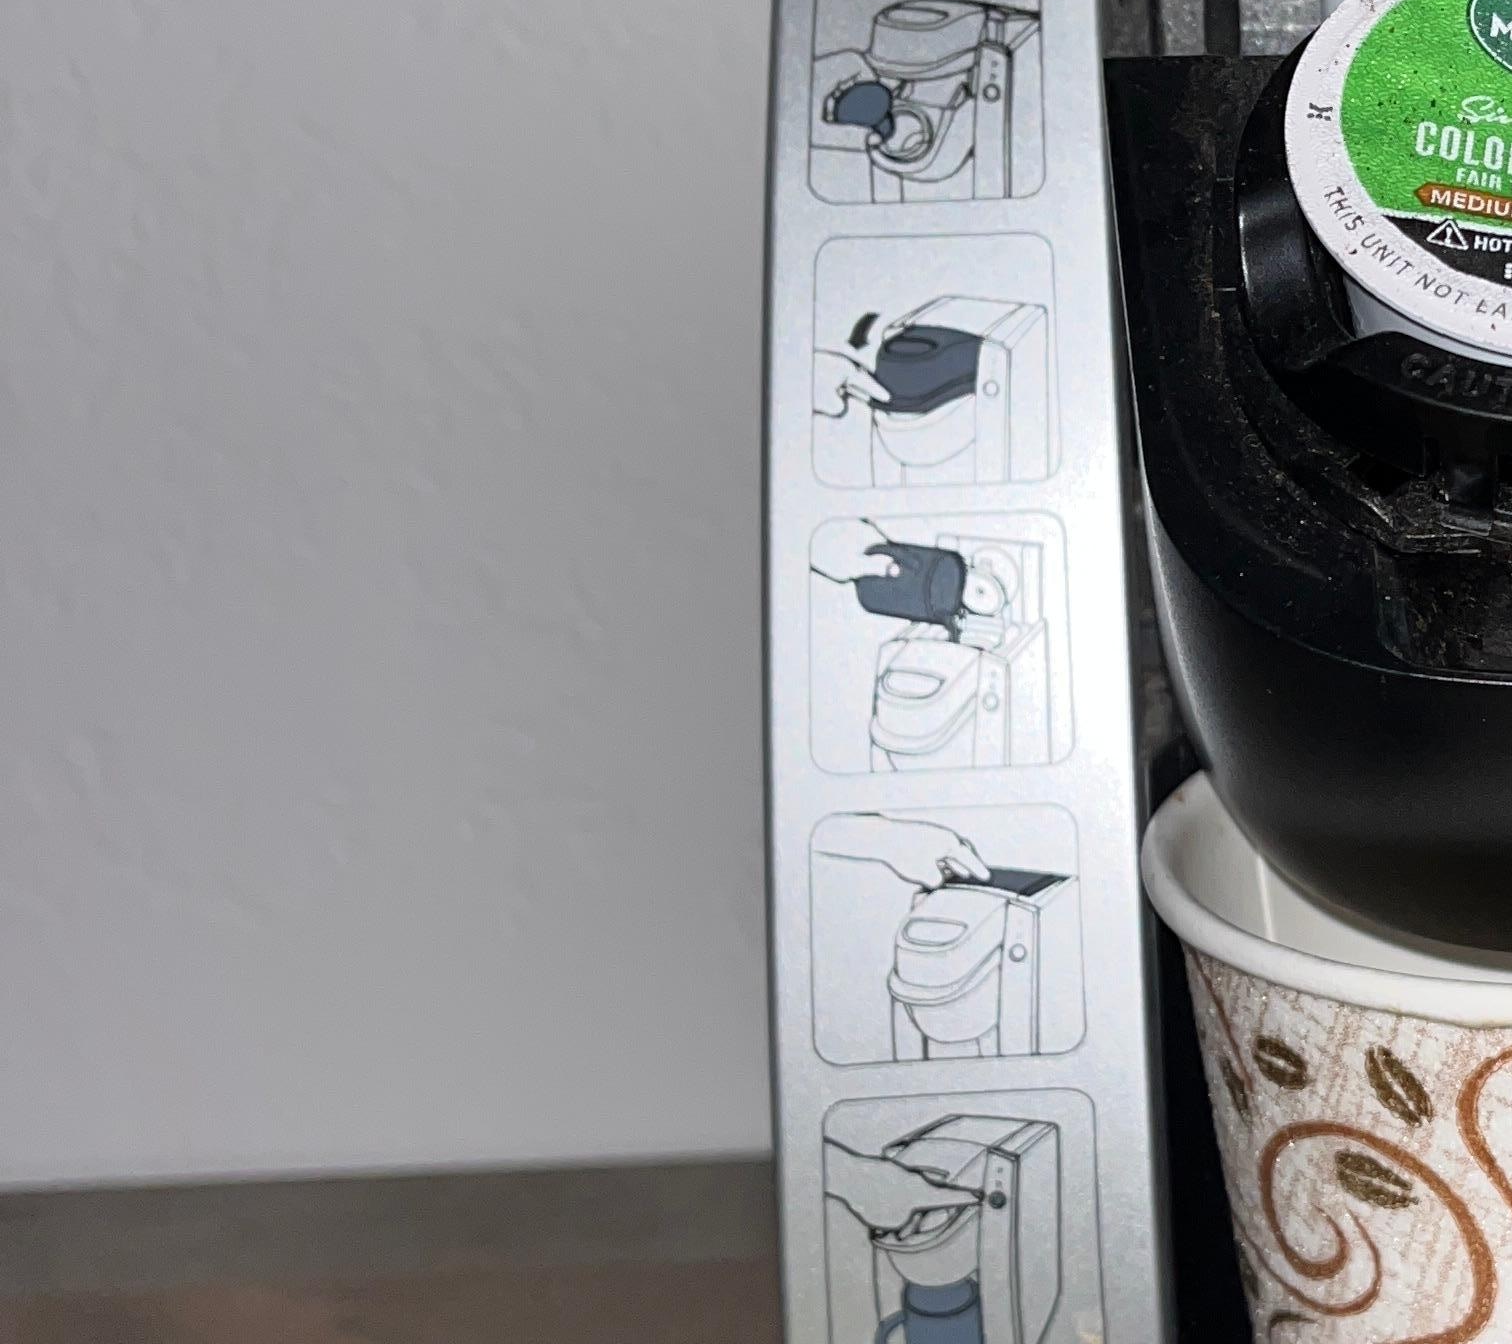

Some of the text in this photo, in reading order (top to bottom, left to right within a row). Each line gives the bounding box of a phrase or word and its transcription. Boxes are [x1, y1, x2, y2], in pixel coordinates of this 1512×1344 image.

[1455, 166, 1502, 191] FAIR
[1323, 185, 1365, 231] THIS
[1360, 232, 1415, 276] UNIT
[1413, 272, 1470, 305] NOT
